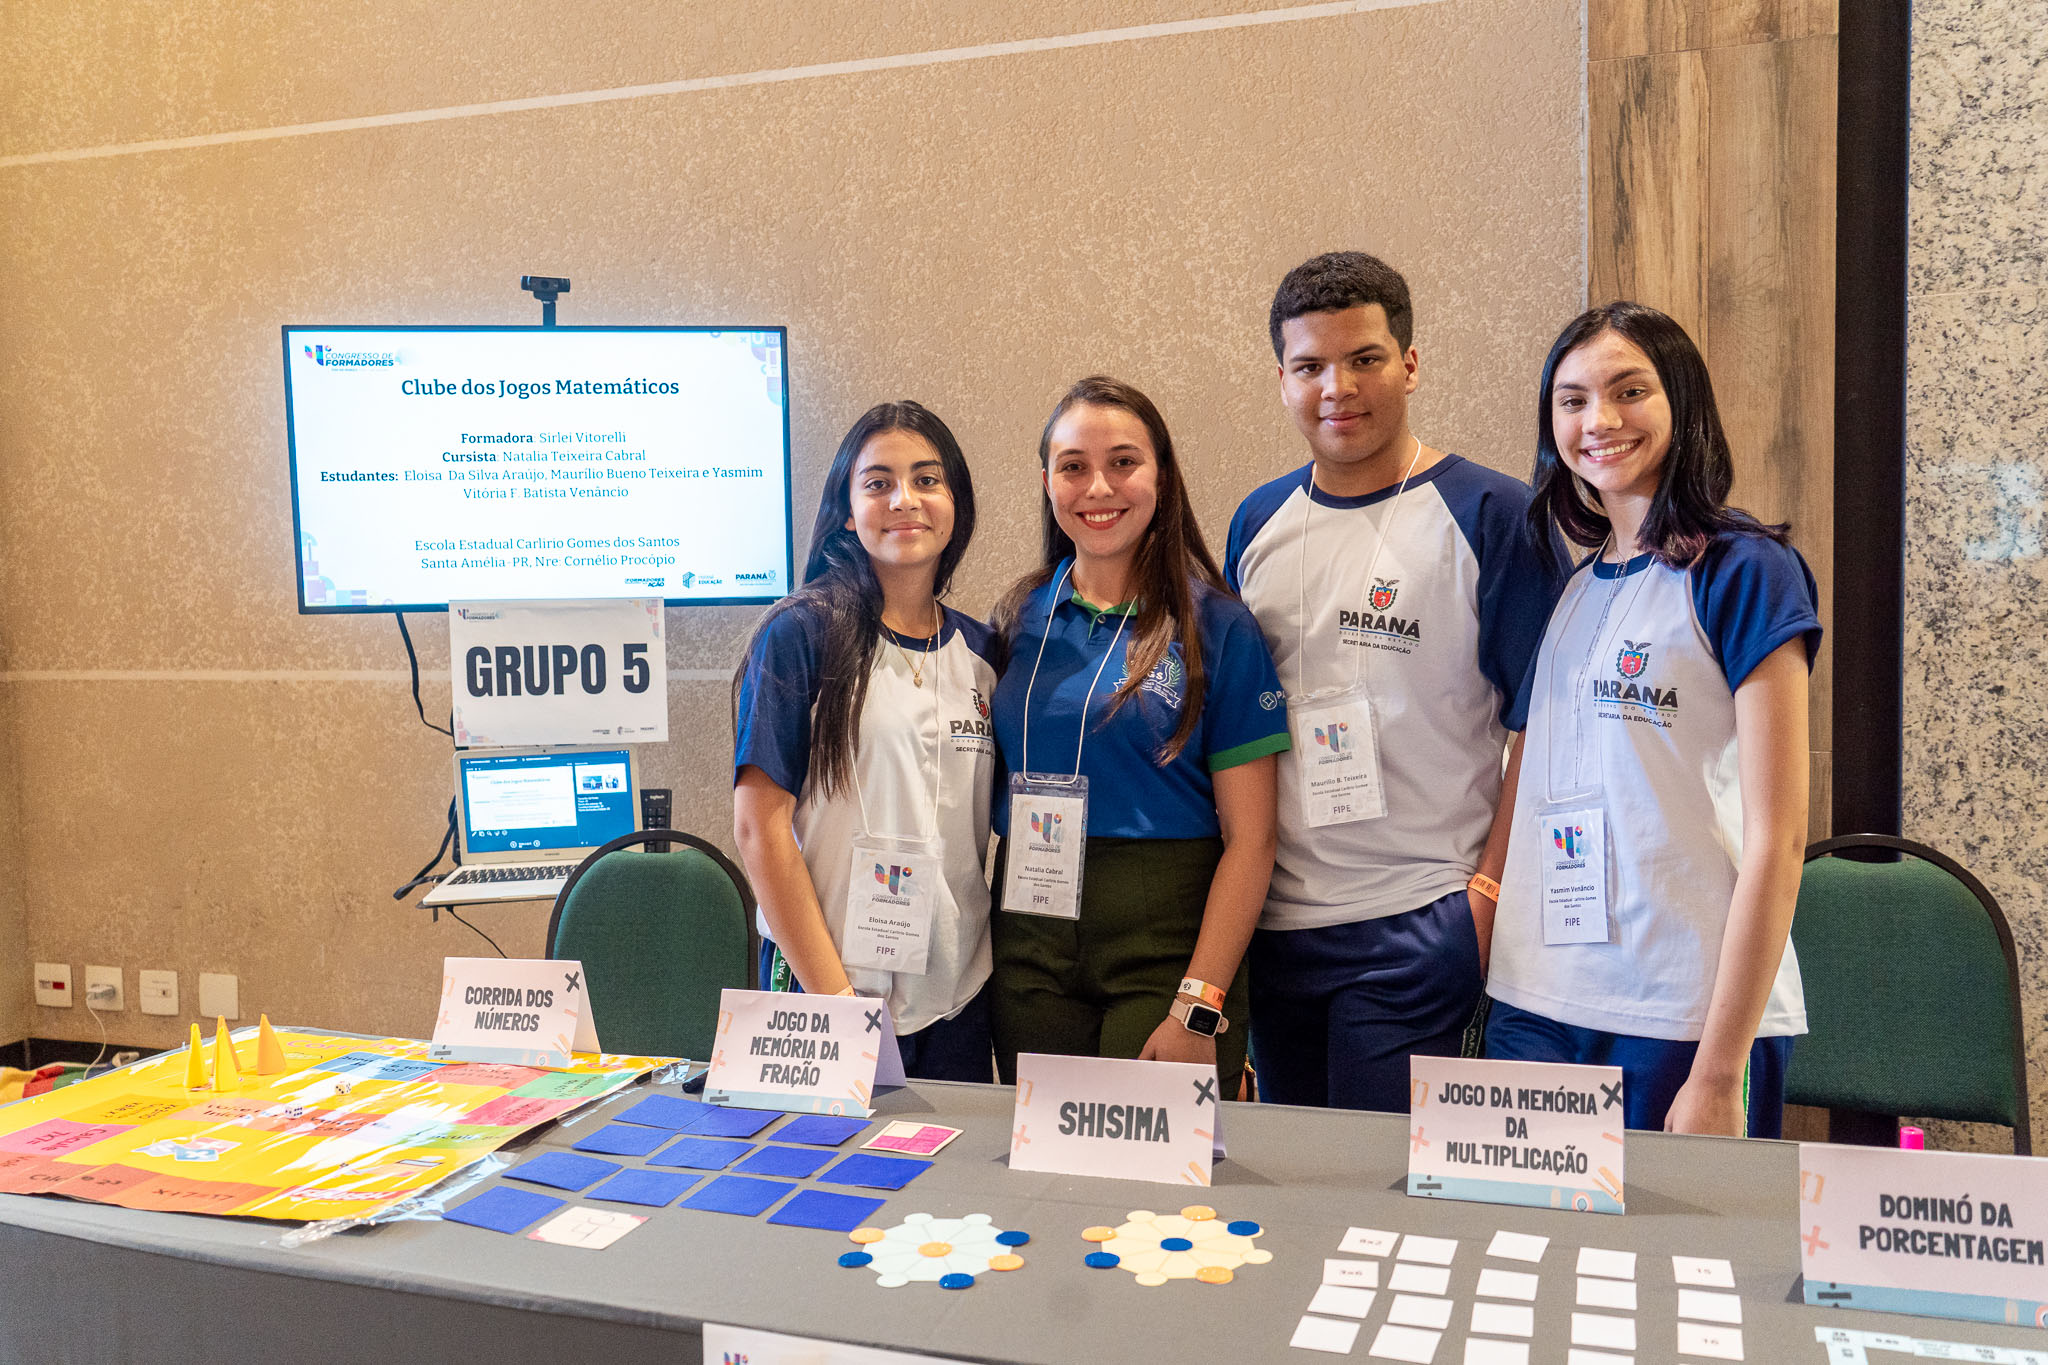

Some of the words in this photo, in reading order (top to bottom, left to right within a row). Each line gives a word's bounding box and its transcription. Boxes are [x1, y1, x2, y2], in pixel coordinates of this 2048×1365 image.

[401, 379, 457, 395] Clube
[461, 379, 496, 395] dos
[498, 379, 551, 399] Jogos
[555, 377, 680, 395] Matemáticos
[576, 431, 627, 443] Vitorelli
[503, 450, 549, 463] Natalia
[551, 450, 603, 462] Teixeira
[605, 449, 646, 461] Cabral
[320, 470, 398, 482] Estudantes:
[404, 469, 442, 481] Eloisa
[449, 470, 465, 481] Da
[468, 469, 499, 481] Silva
[502, 468, 548, 482] Araújo,
[551, 467, 604, 480] Maurílio
[607, 468, 647, 479] Bueno
[648, 467, 700, 479] Teixeira
[702, 470, 710, 478] e
[712, 467, 764, 478] Yasmim
[463, 487, 507, 499] Vitória
[523, 487, 567, 499] Batista
[570, 485, 629, 498] Venâncio
[415, 539, 456, 551] Escola
[459, 538, 514, 550] Estadual
[566, 537, 611, 549] Gomes
[613, 536, 635, 548] dos
[638, 536, 680, 548] Santos
[421, 557, 458, 569] Santa
[564, 554, 618, 567] Cornélio
[621, 553, 675, 567] Procópio
[735, 572, 767, 580] PARANÁ
[1340, 611, 1420, 639] PARANÁ
[1381, 644, 1411, 655] EDUCAÇÃO
[466, 644, 607, 698] GRUPO
[622, 643, 650, 694] 5
[1593, 680, 1678, 708] PARANÁ
[1633, 715, 1672, 728] EDUCAÇÃO
[1344, 773, 1367, 782] Teixeira
[1333, 804, 1351, 814] FIPE
[1024, 865, 1044, 874] Natalia
[1550, 886, 1570, 894] Yasmim
[1032, 895, 1049, 905] FIPE
[869, 916, 888, 925] Eloisa
[889, 918, 911, 928] Araújo
[1565, 917, 1580, 927] FIPE
[876, 946, 896, 956] FIPE
[465, 986, 522, 1007] CORRIDA
[526, 989, 554, 1008] DOS
[474, 1007, 540, 1032] NÚMEROS
[767, 1010, 808, 1033] JOGO
[811, 1013, 830, 1034] DA
[750, 1033, 816, 1059] MEMÓRIA
[820, 1041, 839, 1061] DA
[759, 1061, 820, 1088] FRAÇÃO
[1439, 1083, 1485, 1106] JOGO
[1491, 1086, 1513, 1108] DA
[1517, 1085, 1598, 1115] MEMÓRIA
[1058, 1101, 1170, 1143] SHISIMA
[1505, 1117, 1528, 1139] DA
[1446, 1141, 1588, 1175] MULTIPLICAÇÃO
[1879, 1193, 1973, 1225] DOMINÓ
[1980, 1201, 2013, 1228] DA
[1859, 1225, 2044, 1266] PORCENTAGEM
